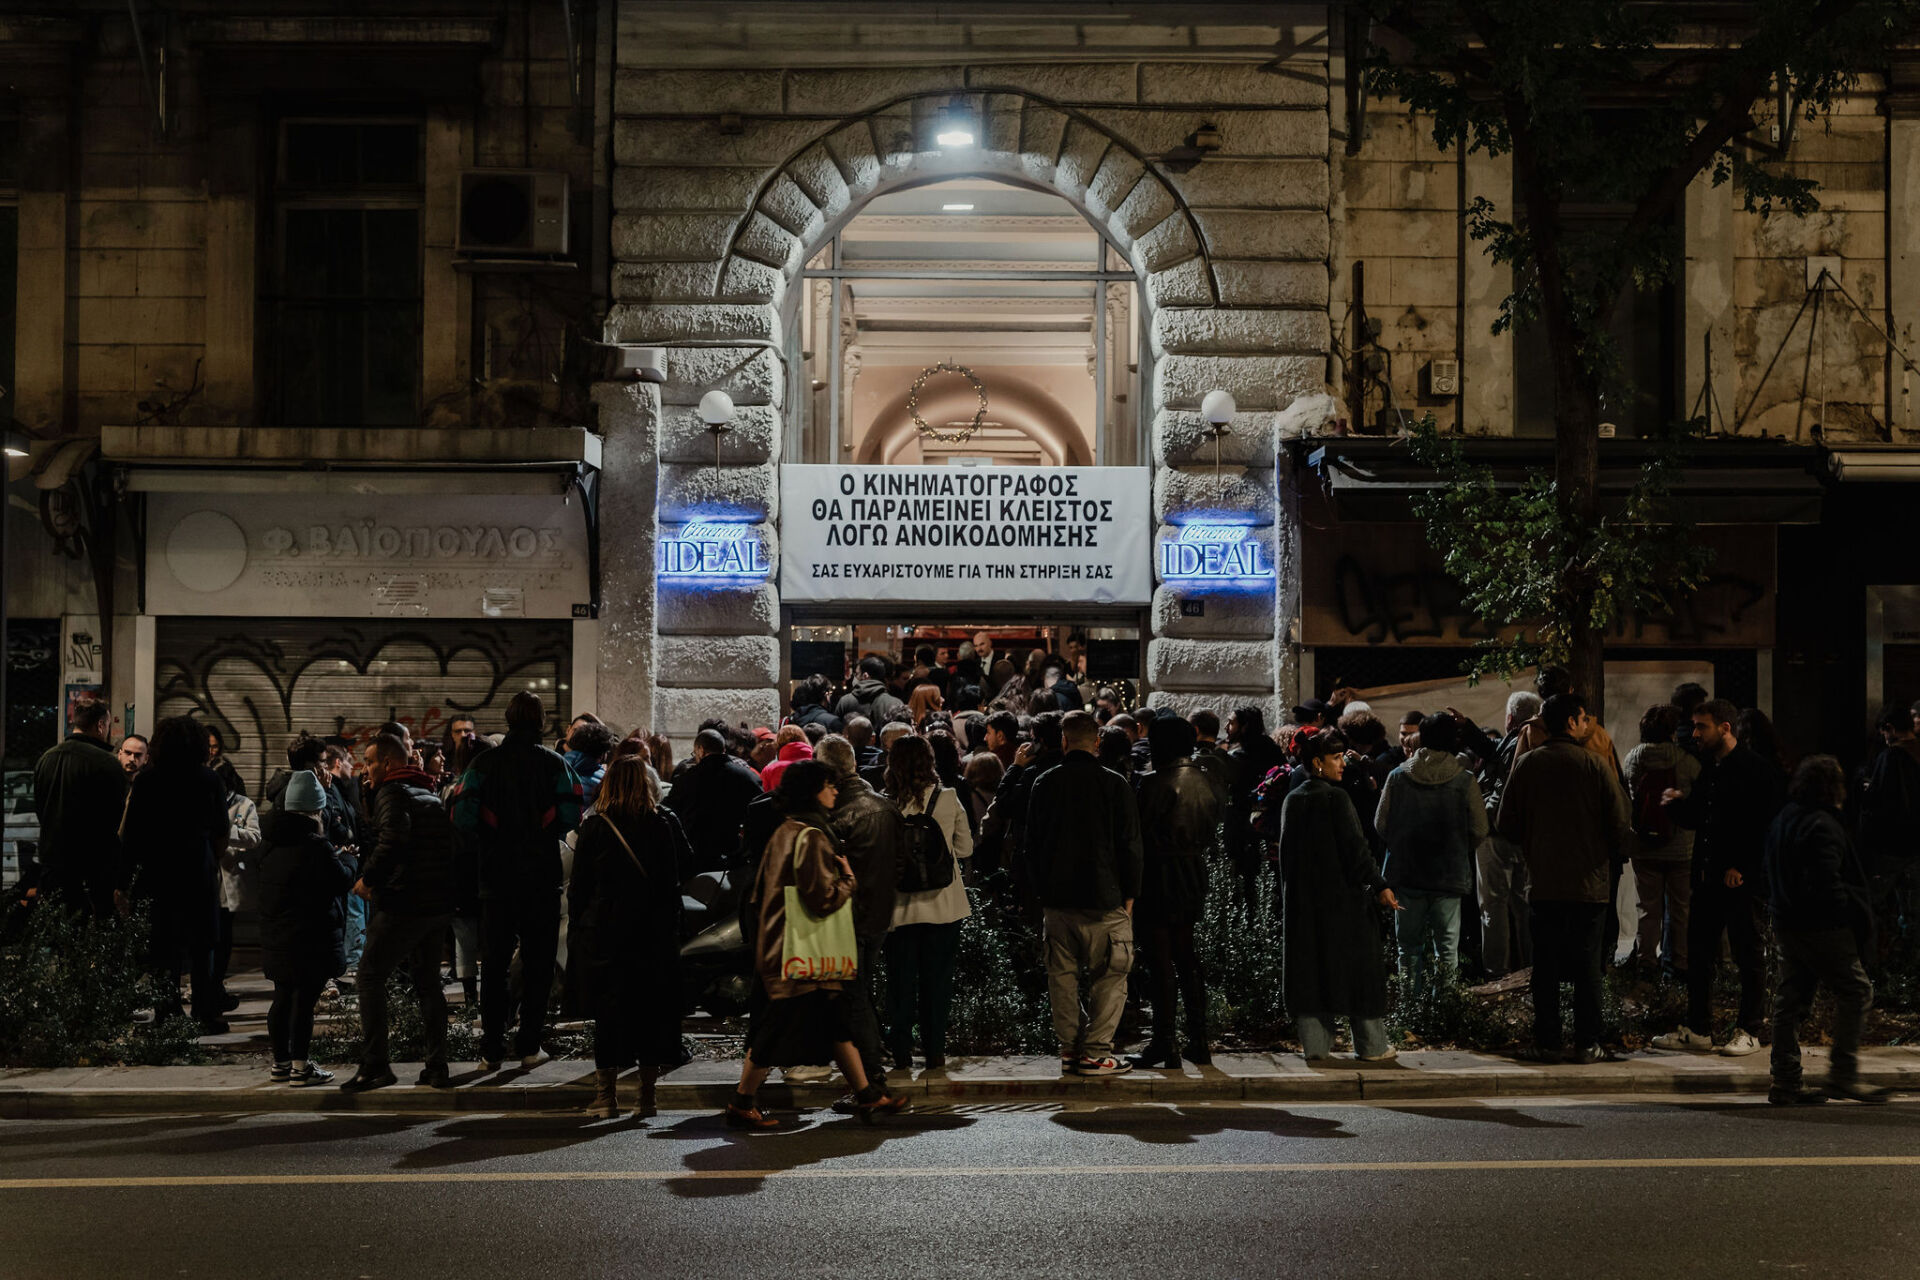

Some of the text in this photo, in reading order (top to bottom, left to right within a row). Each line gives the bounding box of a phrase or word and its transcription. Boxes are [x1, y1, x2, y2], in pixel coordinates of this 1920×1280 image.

[840, 473, 1078, 497] Ο ΚΙΝΗΜΑΤΟΓΡΑΦΟΣ
[812, 499, 1113, 522] ΘΑ ΠΑΡΑΜΕΙΝΕΙ ΚΛΕΙΣΤΟΣ
[262, 518, 562, 557] Φ. ΒΑΪΟΠΟΥΛΟΣ
[681, 522, 743, 540] Cinema
[826, 524, 1098, 547] ΛΟΓΩ ΑΝΟΙΚΟΔΟΜΗΣΗΣ
[1182, 524, 1246, 542] Cinema
[661, 539, 770, 574] IDEAL
[1161, 543, 1272, 577] IDEAL
[812, 563, 1113, 579] ΣΑΣ ΕΥΧΑΡΙΣΤΟΥΜΕ ΓΙΑ ΤΗΝ ΣΤΗΡΙΞΗ ΣΑΣ
[574, 606, 587, 615] 46
